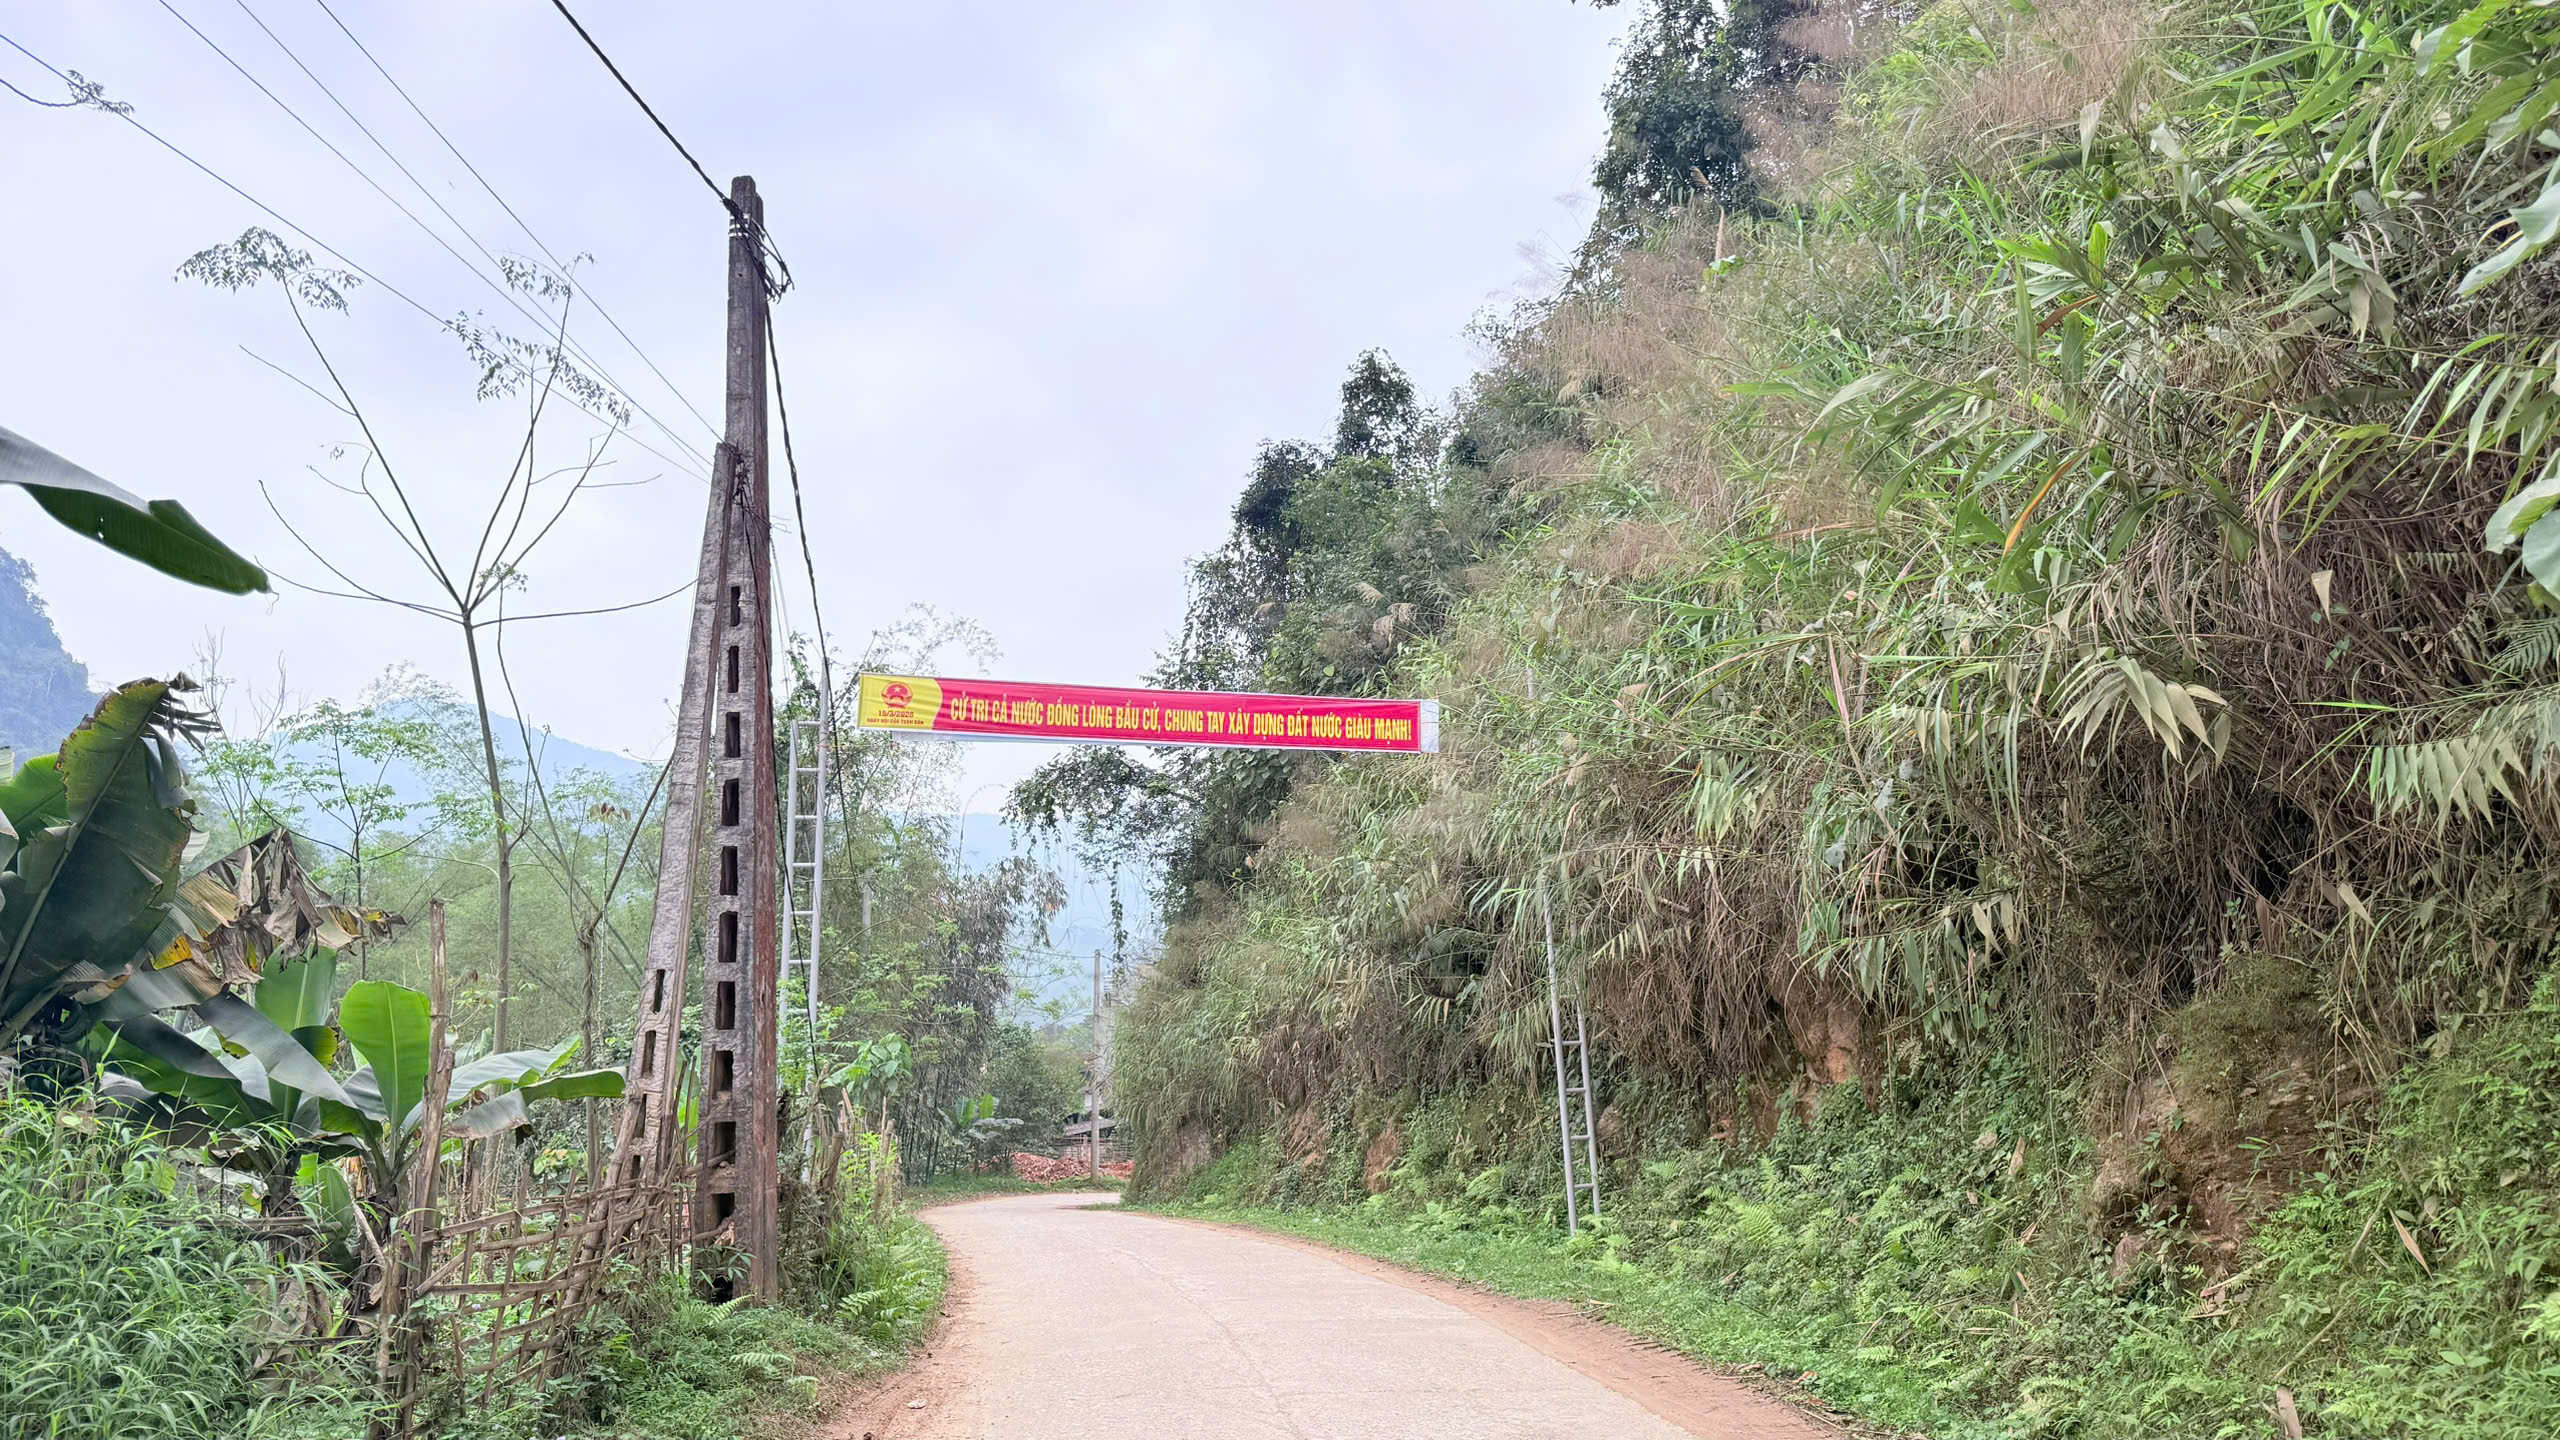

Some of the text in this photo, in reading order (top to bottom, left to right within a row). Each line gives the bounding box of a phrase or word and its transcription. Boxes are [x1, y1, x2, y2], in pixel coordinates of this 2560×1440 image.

[950, 691, 1412, 745] CỬ TRI CẢ NƯỚC ĐỒNG LÒNG BẦU CỬ, CHUNG TAY XÂY DỰNG ĐẤT NƯỚC GIÀU MẠNH!
